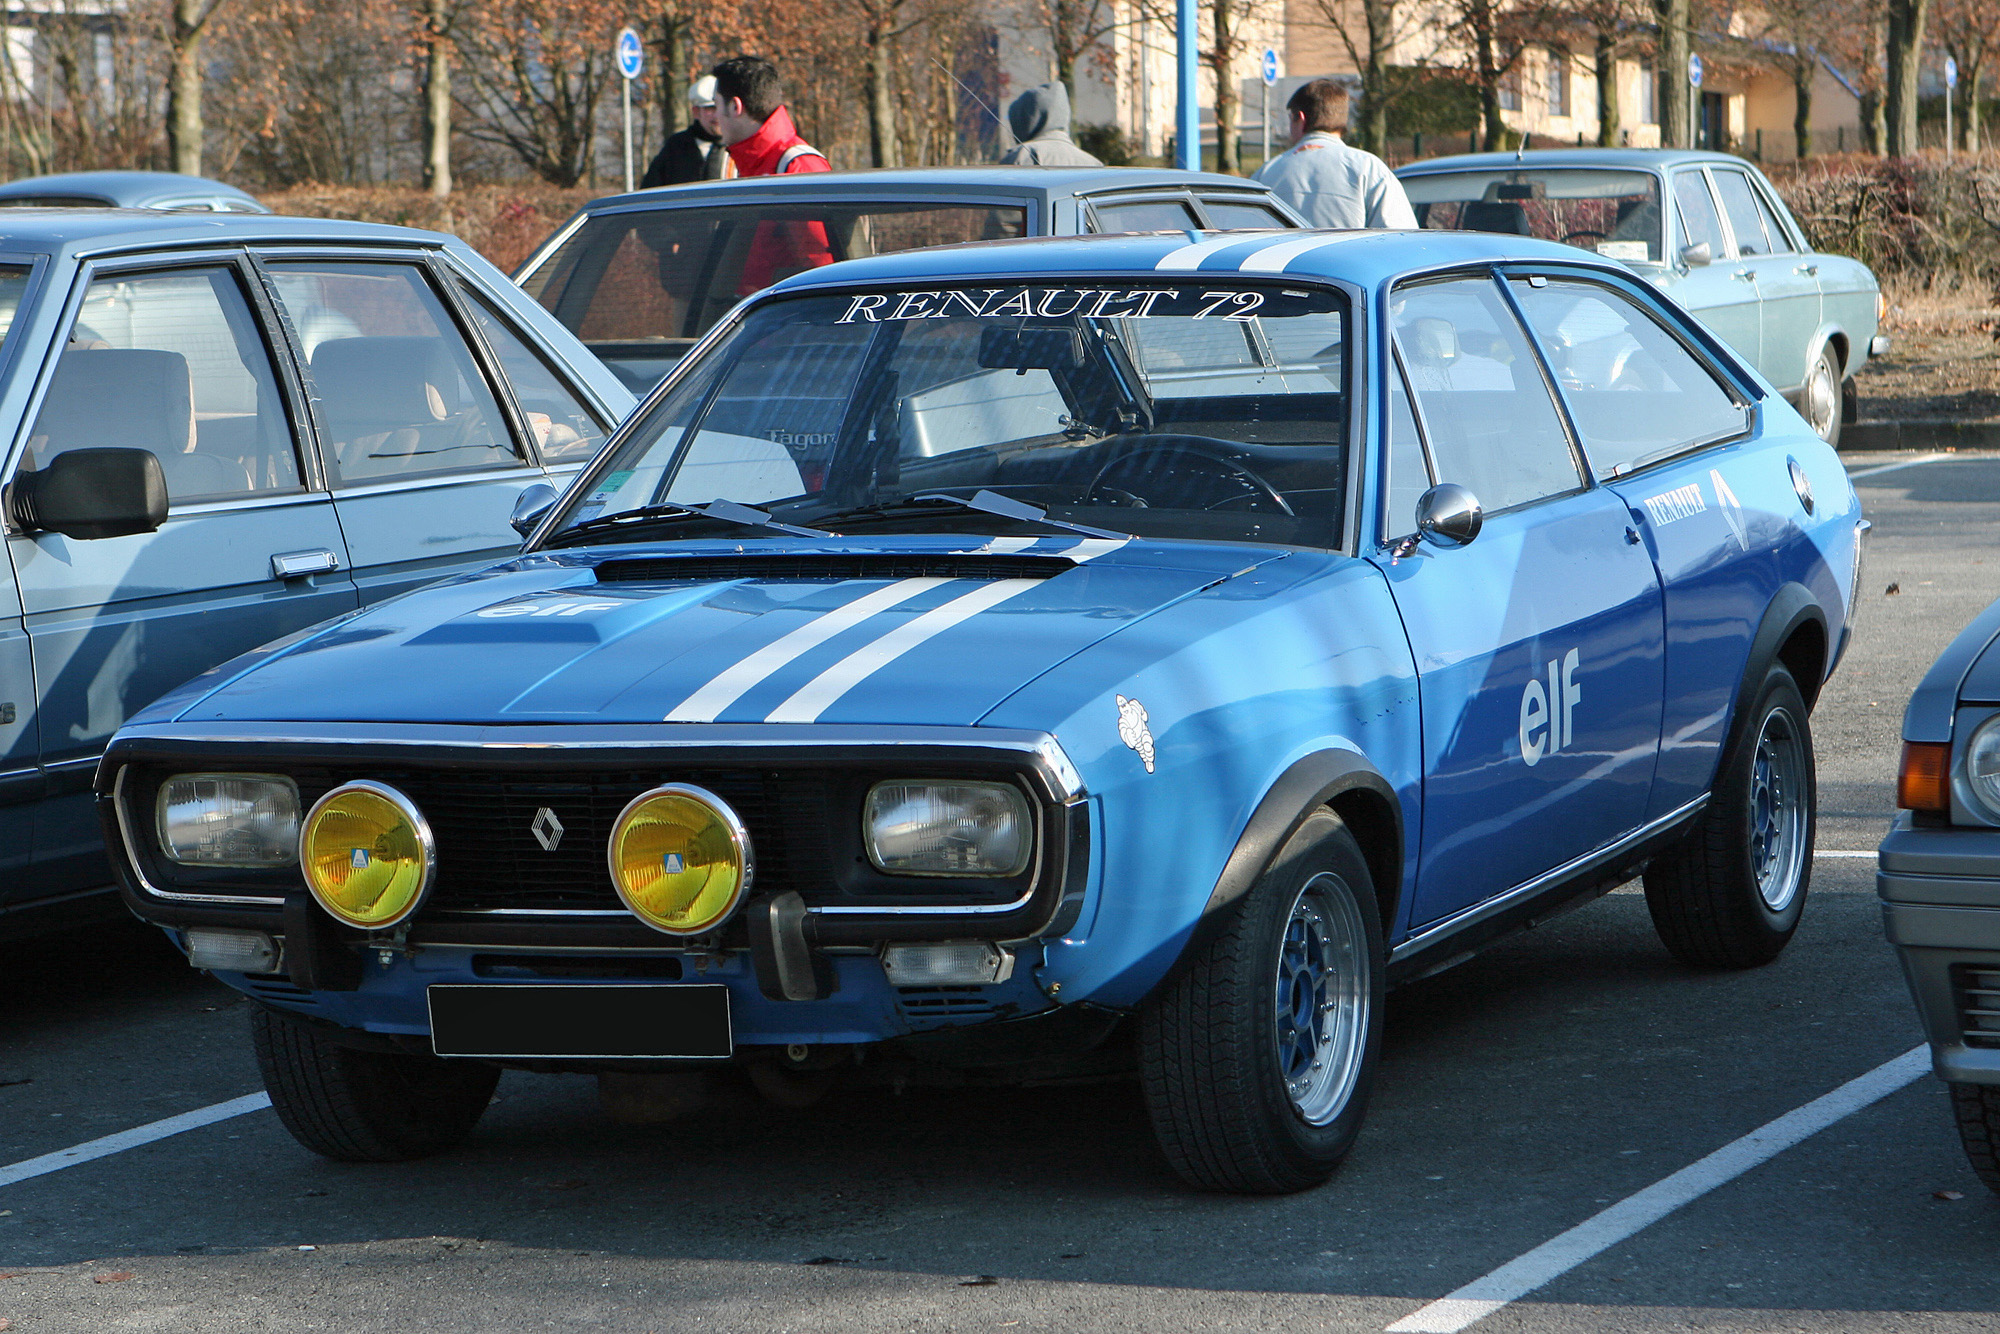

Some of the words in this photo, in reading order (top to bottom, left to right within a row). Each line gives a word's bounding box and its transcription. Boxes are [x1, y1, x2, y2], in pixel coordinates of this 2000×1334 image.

[834, 288, 1180, 324] RENAULT
[1191, 290, 1265, 322] 72
[764, 429, 836, 451] Tagor
[1643, 483, 1707, 527] RENAULT
[477, 602, 623, 618] elf
[1519, 647, 1581, 767] elf
